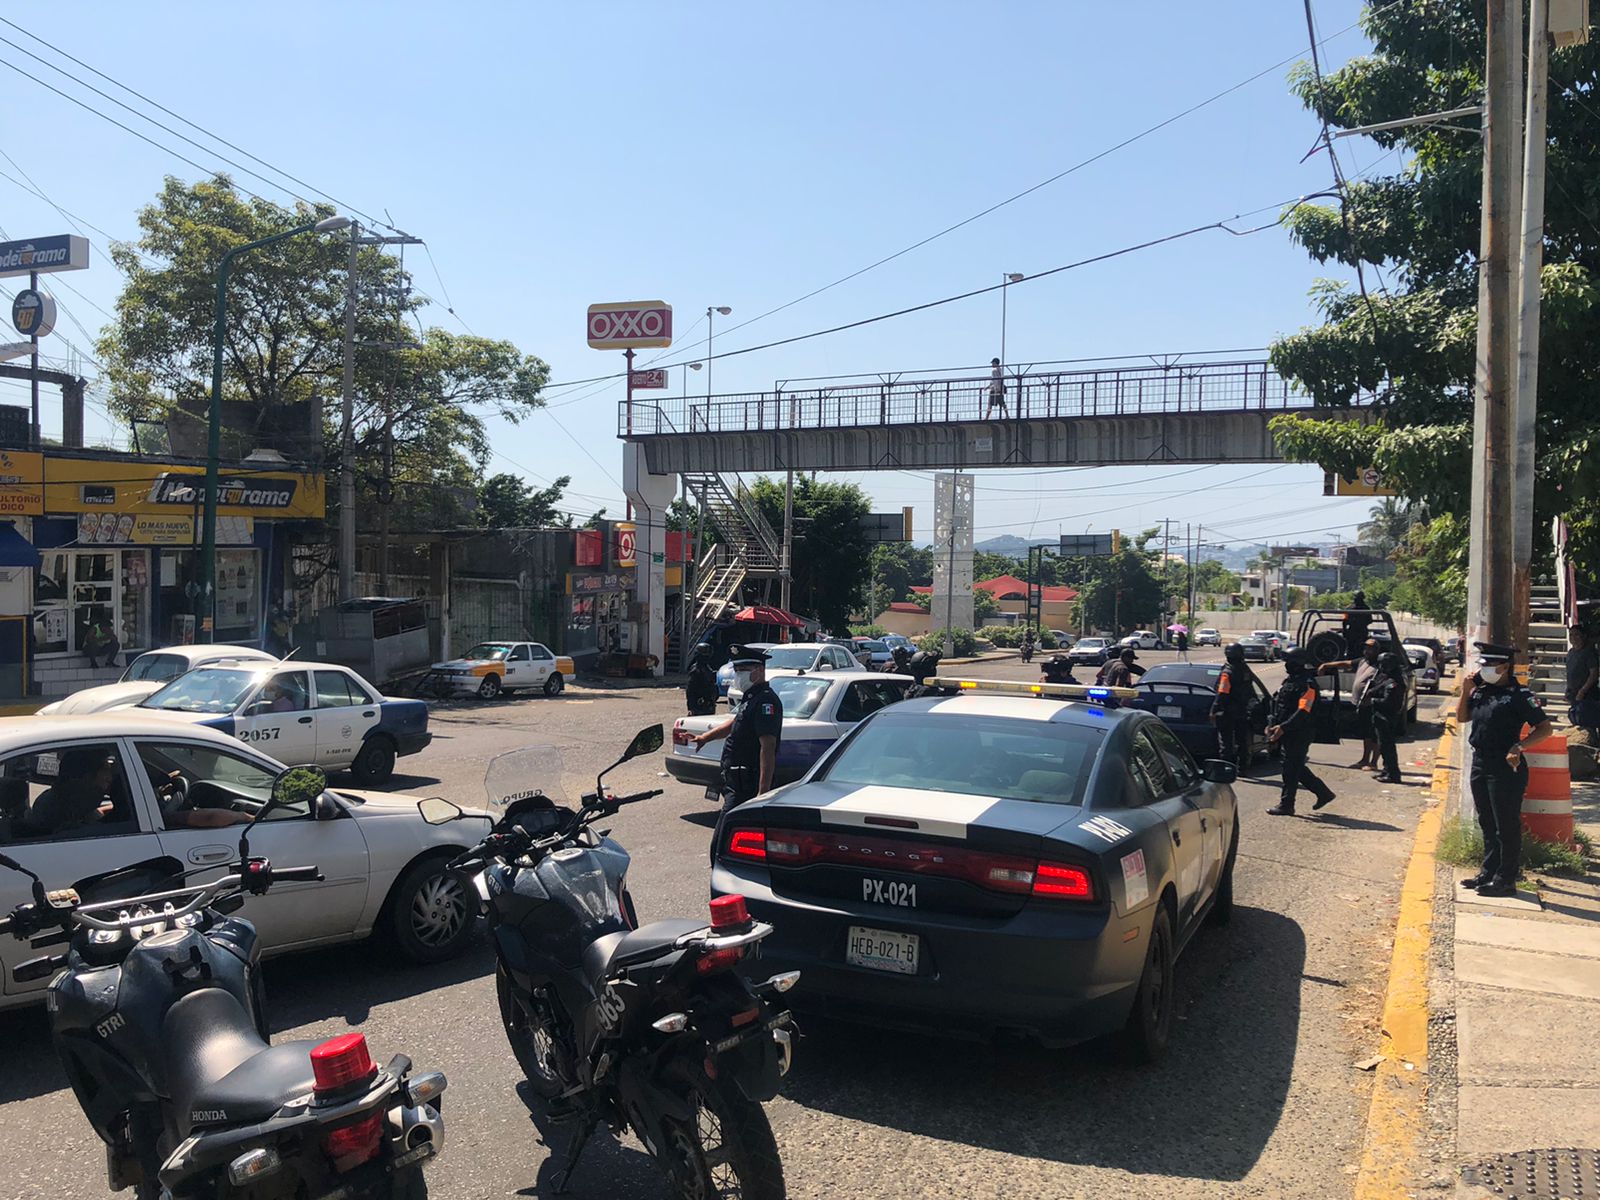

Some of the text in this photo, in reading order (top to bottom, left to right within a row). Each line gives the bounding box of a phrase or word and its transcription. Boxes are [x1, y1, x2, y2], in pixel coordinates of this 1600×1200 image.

[590, 311, 663, 338] OXXO
[240, 727, 280, 742] 2057
[862, 878, 917, 908] PX-021
[851, 936, 914, 962] HEB-021-B
[96, 1012, 126, 1039] GTRI
[191, 1109, 228, 1121] HONDA
